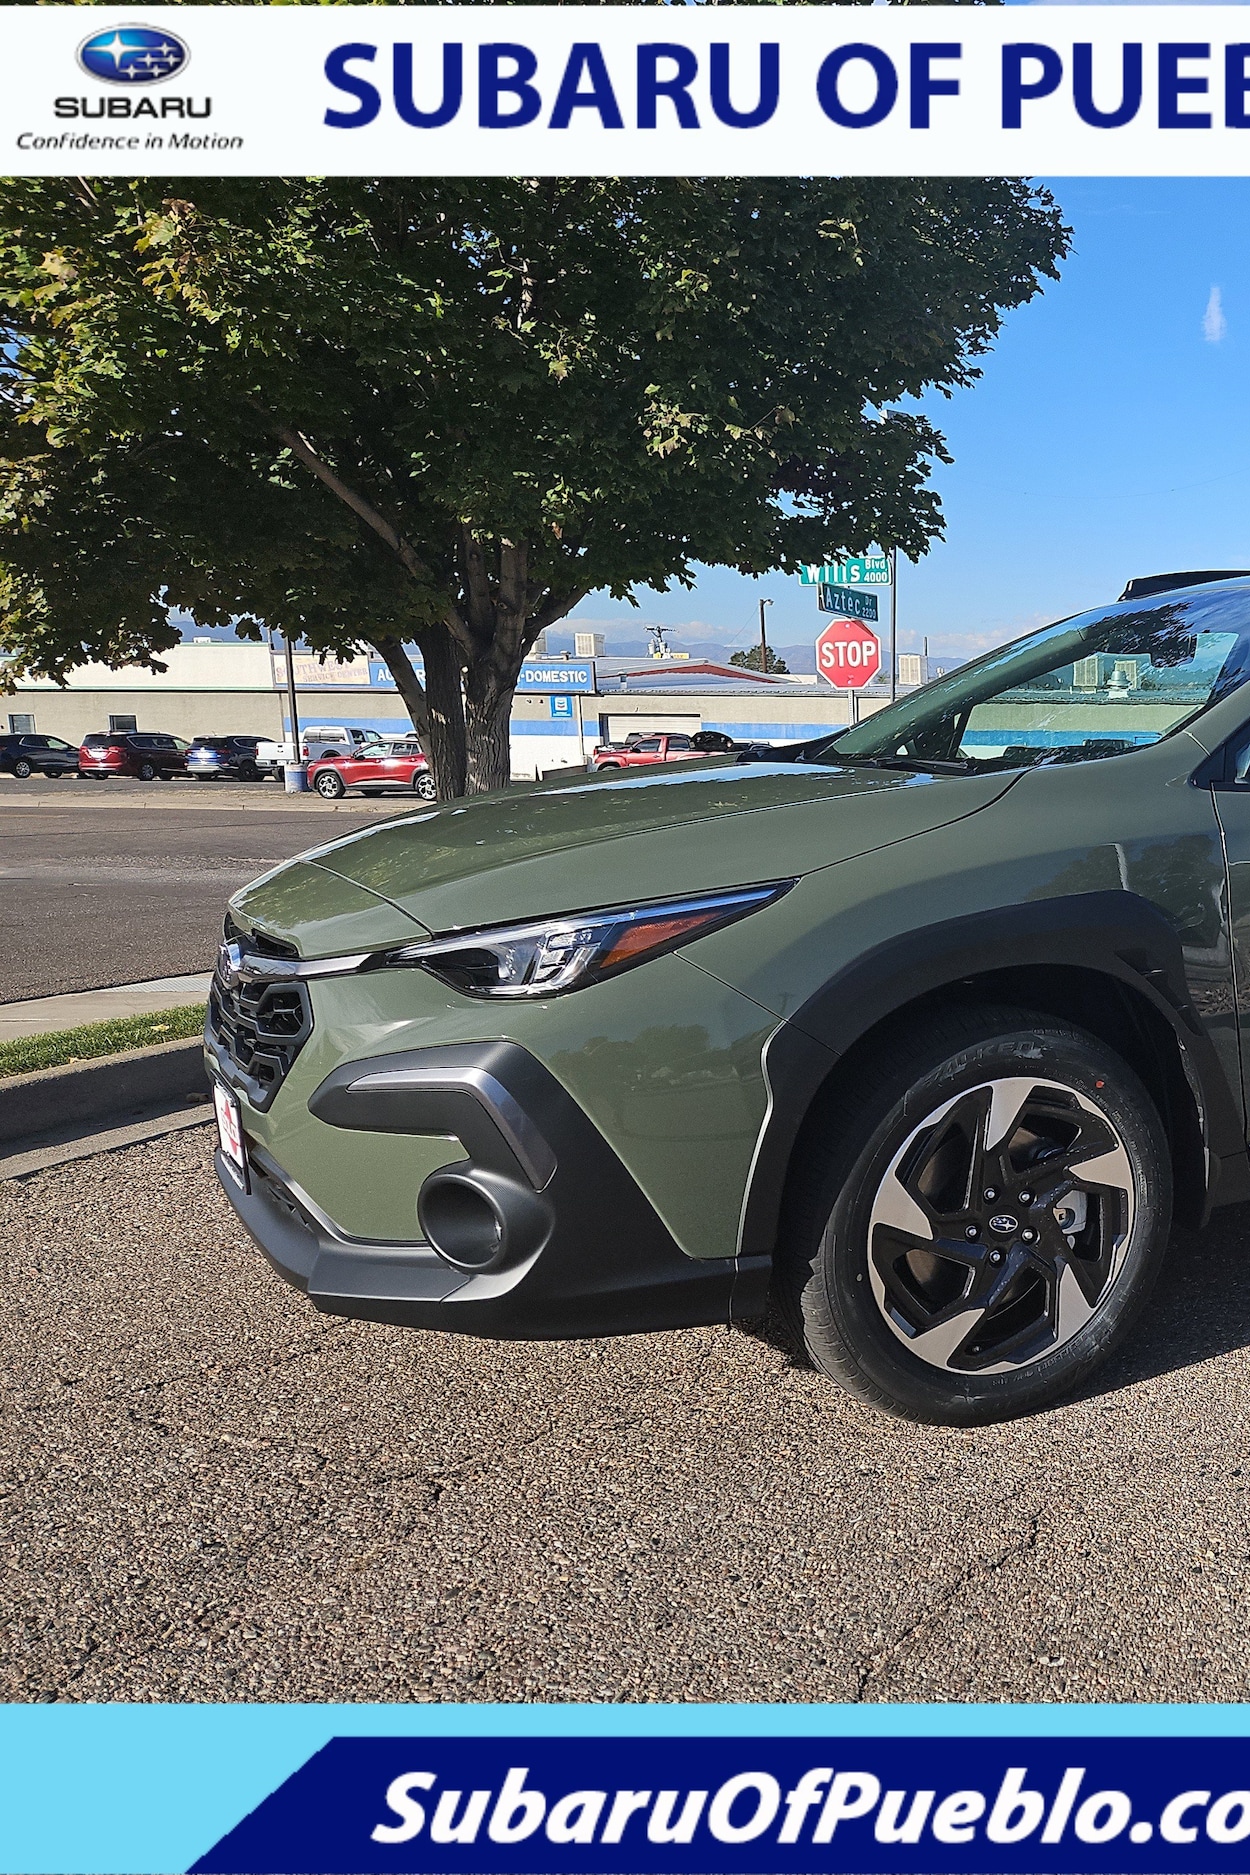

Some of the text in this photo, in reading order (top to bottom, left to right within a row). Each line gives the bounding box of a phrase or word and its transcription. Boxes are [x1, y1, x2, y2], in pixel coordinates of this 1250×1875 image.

[864, 572, 888, 582] 4000
[825, 586, 861, 615] Aztec
[821, 640, 876, 668] STOP
